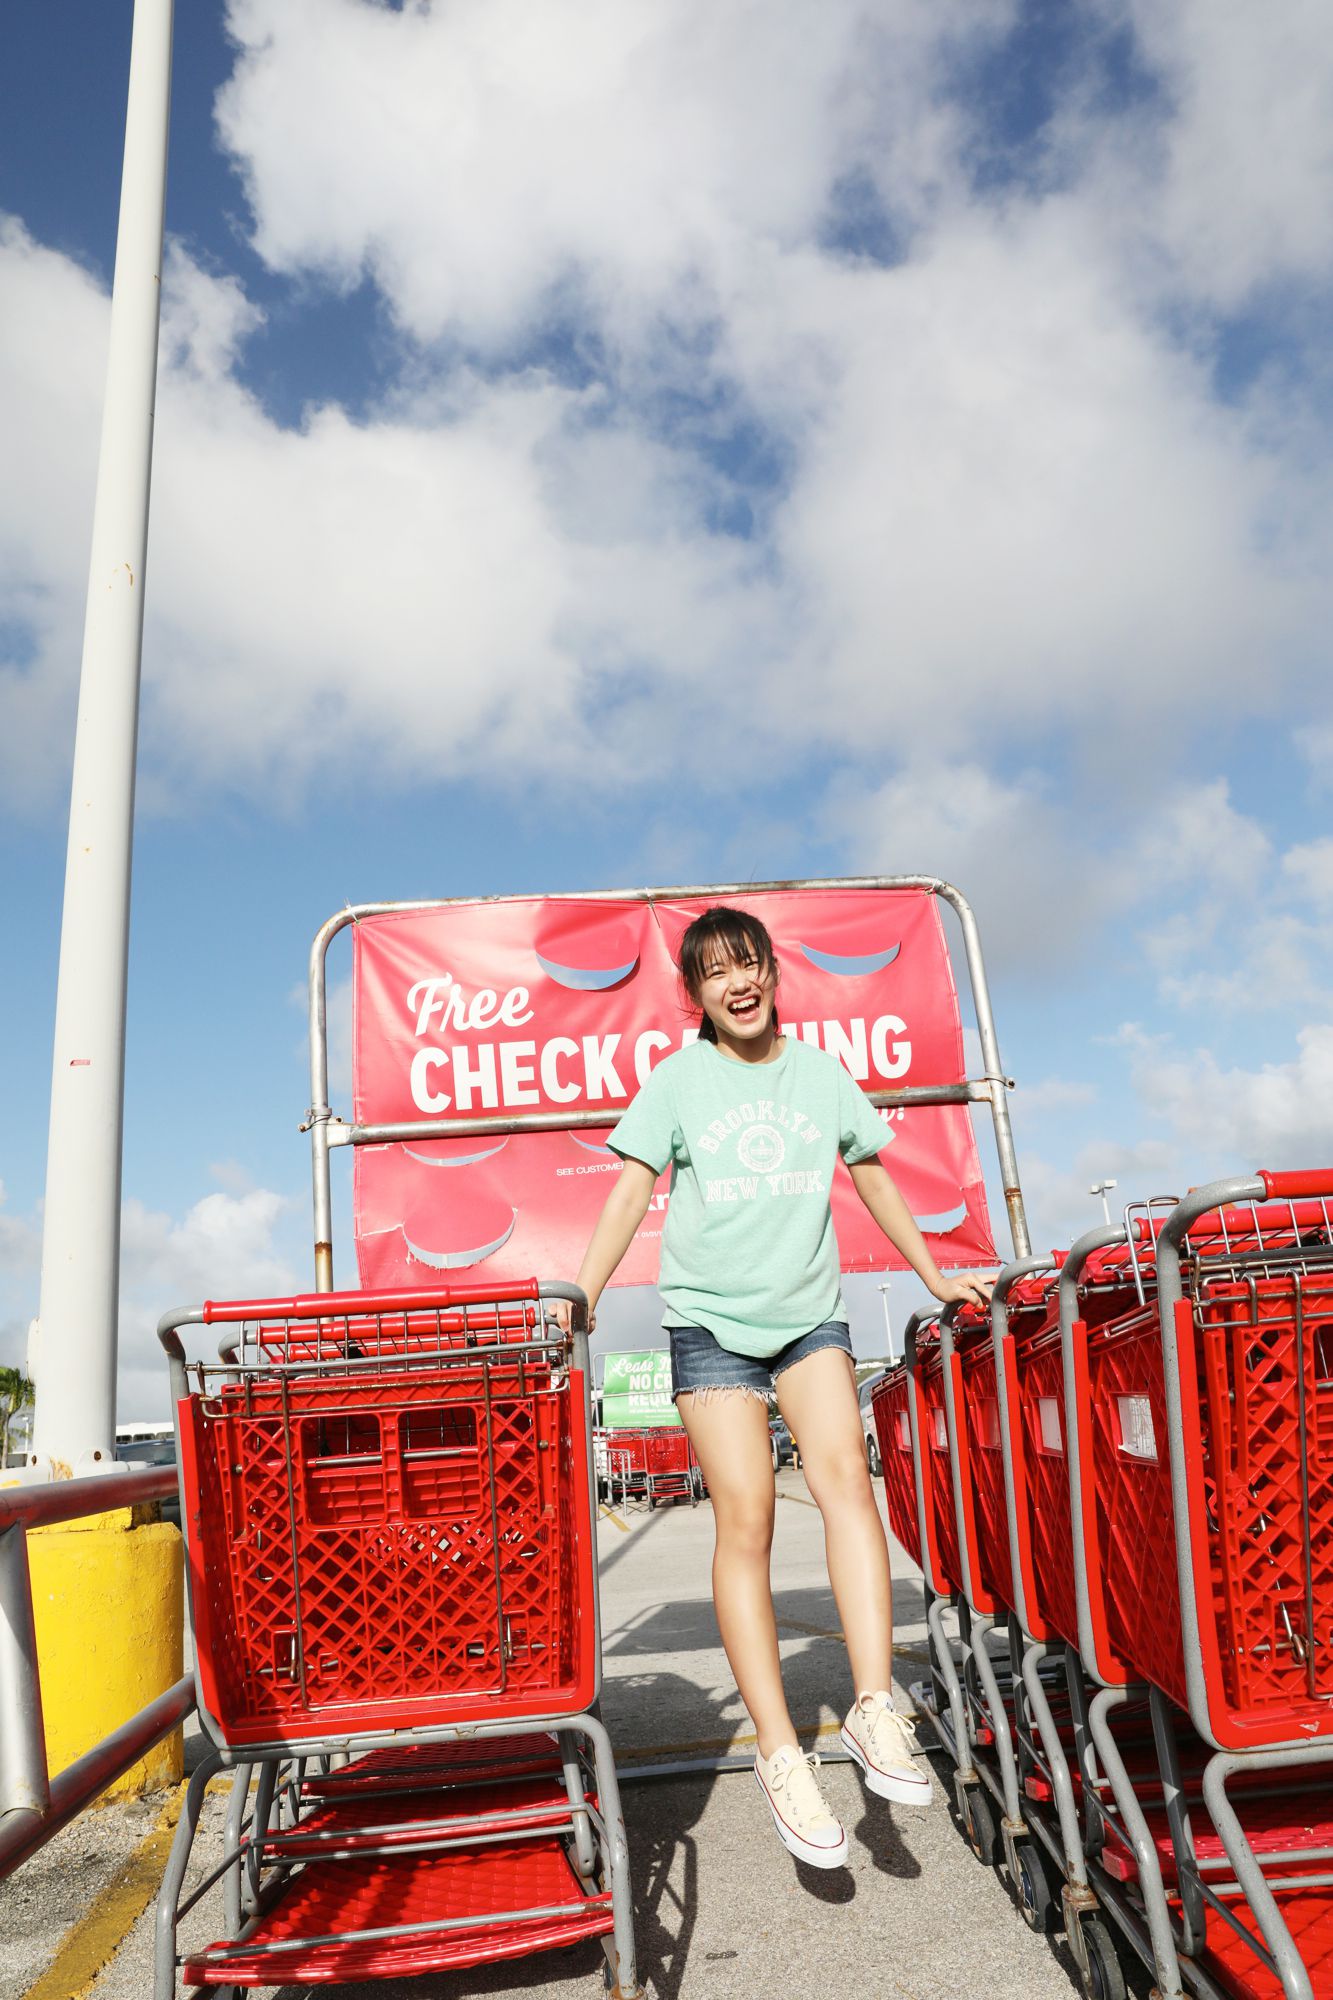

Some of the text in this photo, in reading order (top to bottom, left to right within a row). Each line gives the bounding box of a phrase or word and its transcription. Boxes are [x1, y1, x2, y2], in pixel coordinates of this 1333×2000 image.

[406, 972, 534, 1036] Free
[410, 1034, 628, 1113] CHECK
[697, 1100, 823, 1155] BROOKLYN
[556, 1168, 575, 1177] SEE
[705, 1170, 826, 1202] NEW YORK
[611, 1358, 654, 1377] Lease
[629, 1373, 651, 1391] NO
